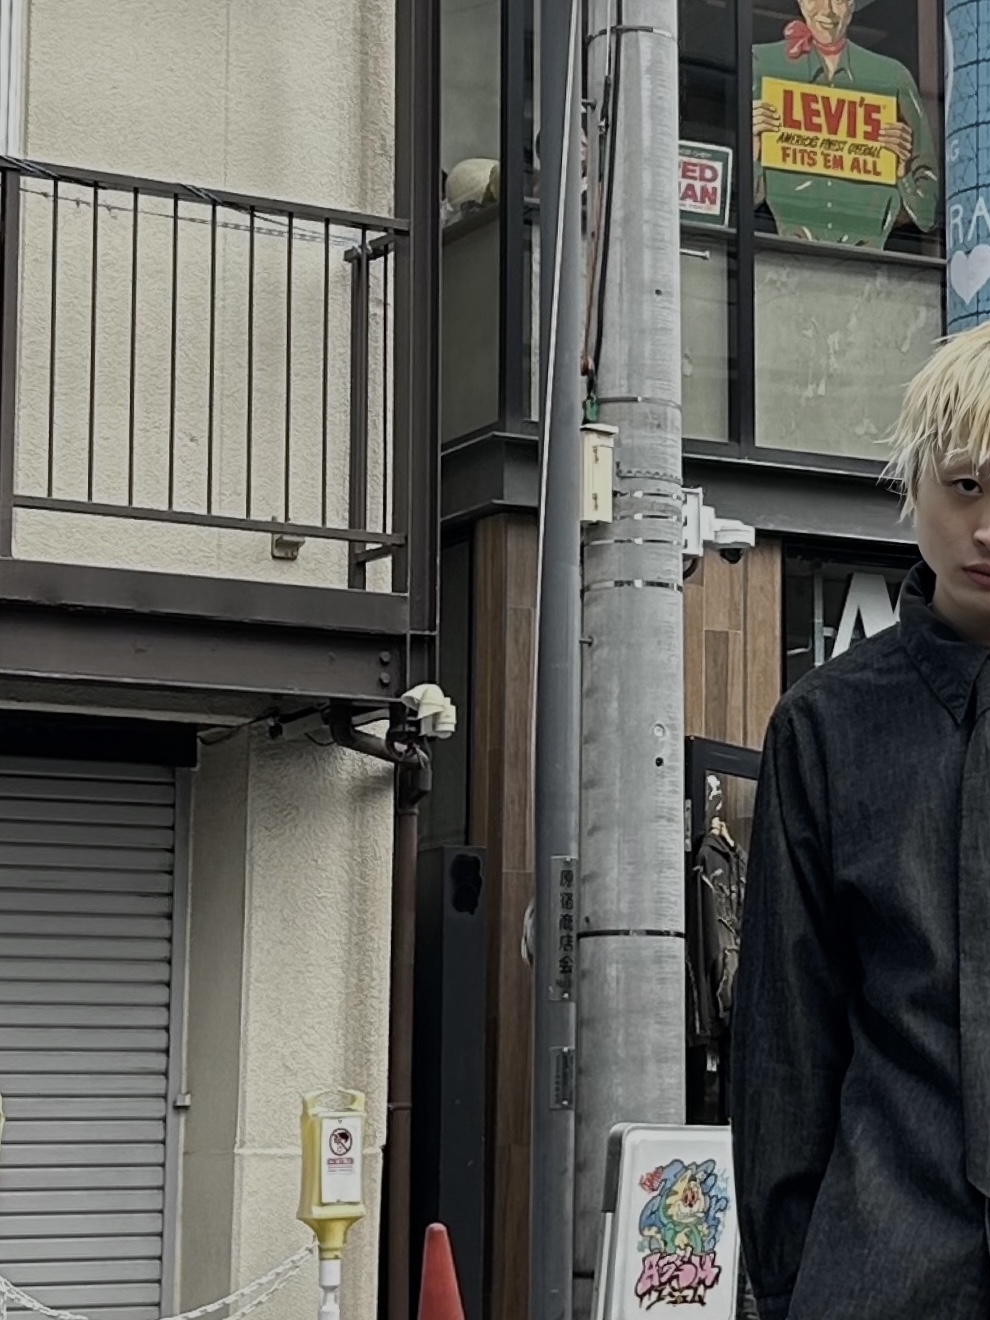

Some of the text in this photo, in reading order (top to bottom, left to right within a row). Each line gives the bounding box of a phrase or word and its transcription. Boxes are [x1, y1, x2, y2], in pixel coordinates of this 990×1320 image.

[782, 88, 882, 143] LEVI'S
[678, 160, 719, 184] ED
[781, 146, 882, 177] FITS 'EM ALL
[678, 181, 718, 206] AN
